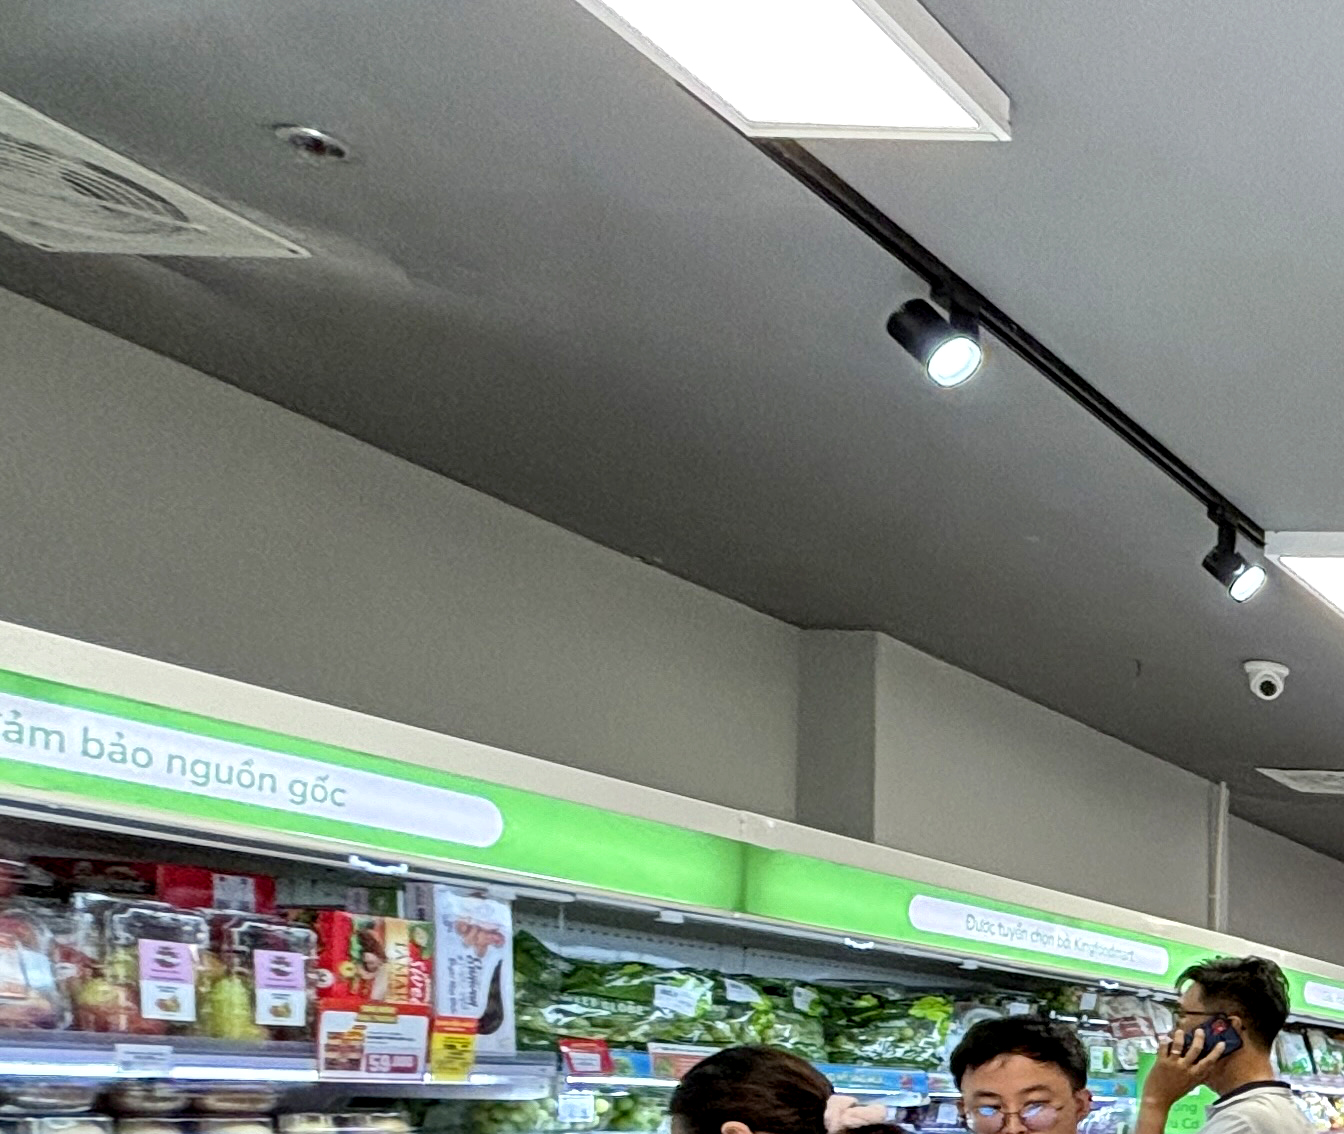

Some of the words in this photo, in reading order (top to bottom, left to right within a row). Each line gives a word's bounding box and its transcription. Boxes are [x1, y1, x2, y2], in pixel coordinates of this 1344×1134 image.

[0, 710, 66, 754] ảm
[81, 726, 153, 770] bảo
[166, 752, 278, 794] nguồn
[288, 774, 347, 807] gốc
